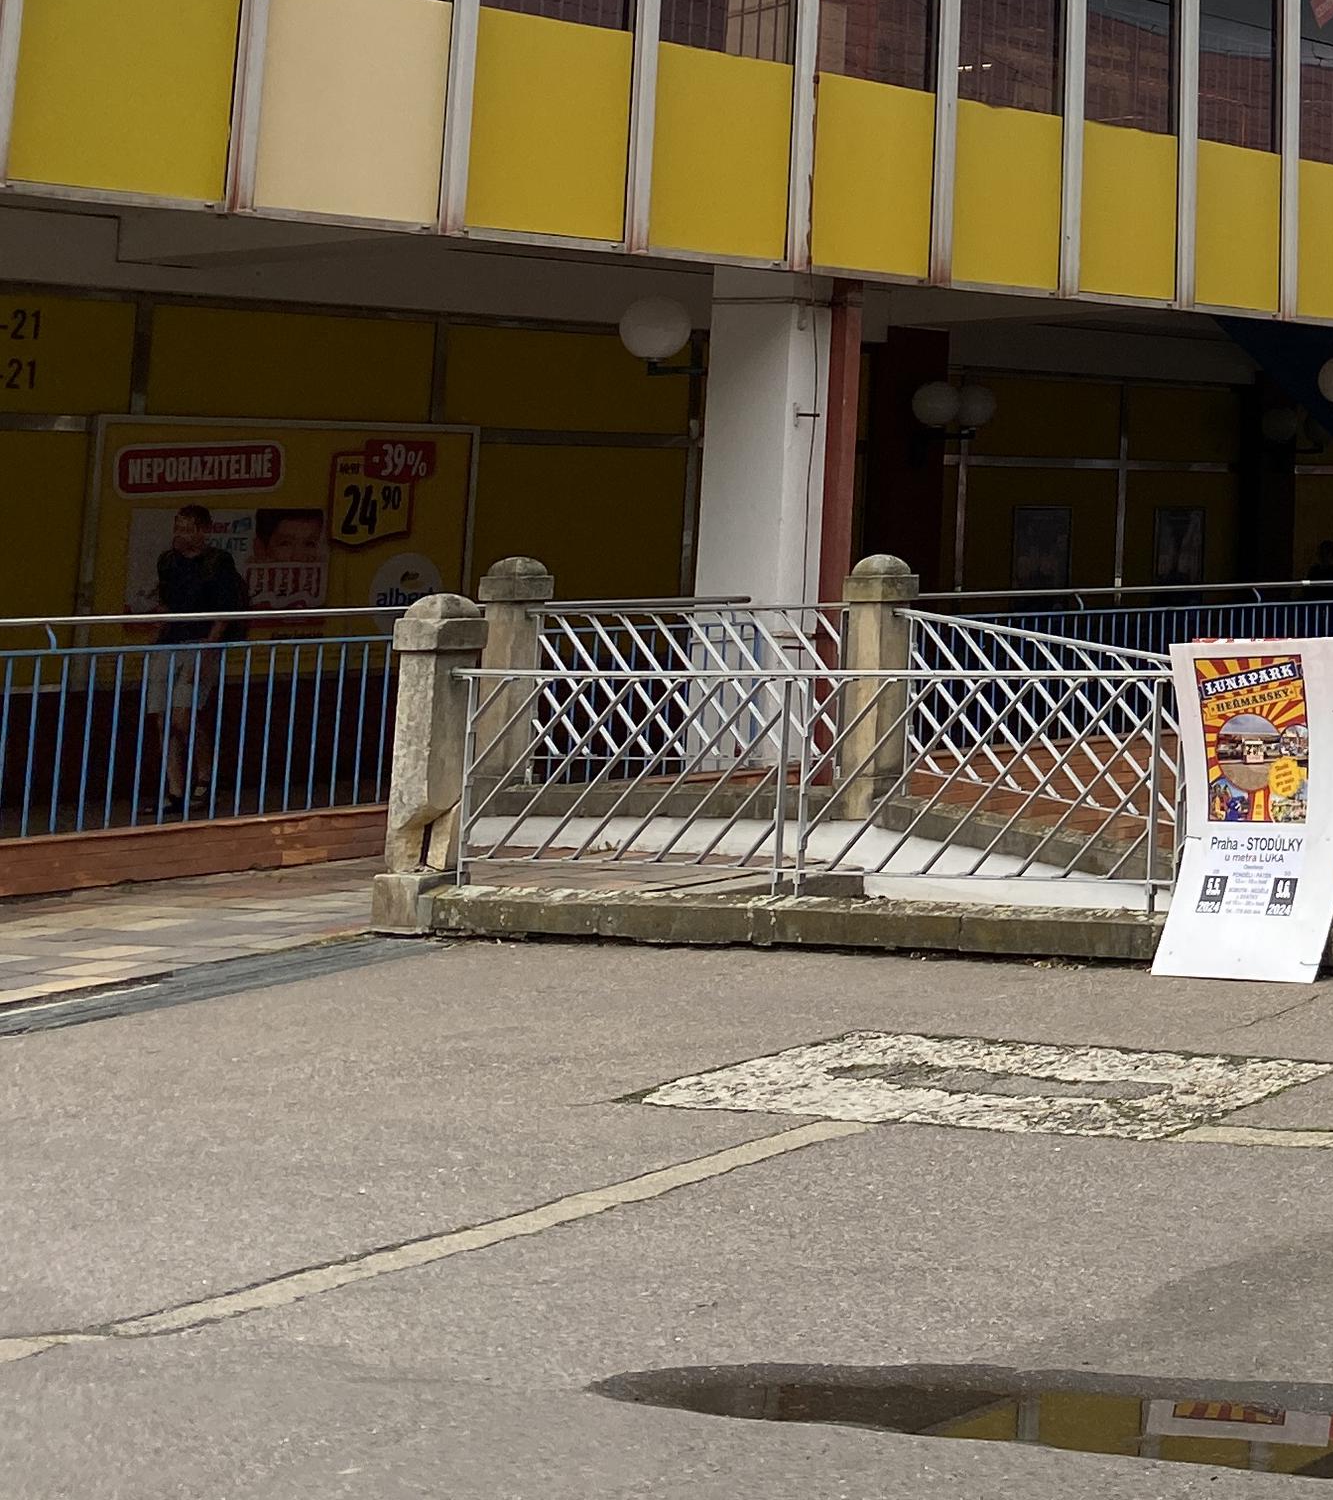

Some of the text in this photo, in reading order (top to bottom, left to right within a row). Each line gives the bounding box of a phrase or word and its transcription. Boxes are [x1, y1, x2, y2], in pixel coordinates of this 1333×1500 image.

[126, 447, 273, 485] NEPORAZITELNÉ
[372, 443, 428, 477] -39%
[1204, 663, 1295, 696] LUNAPARK
[1210, 836, 1239, 850] Praha
[1232, 853, 1257, 862] metra
[1259, 853, 1285, 863] LUKA
[1196, 900, 1221, 913] 2024
[1266, 903, 1292, 916] 2024
